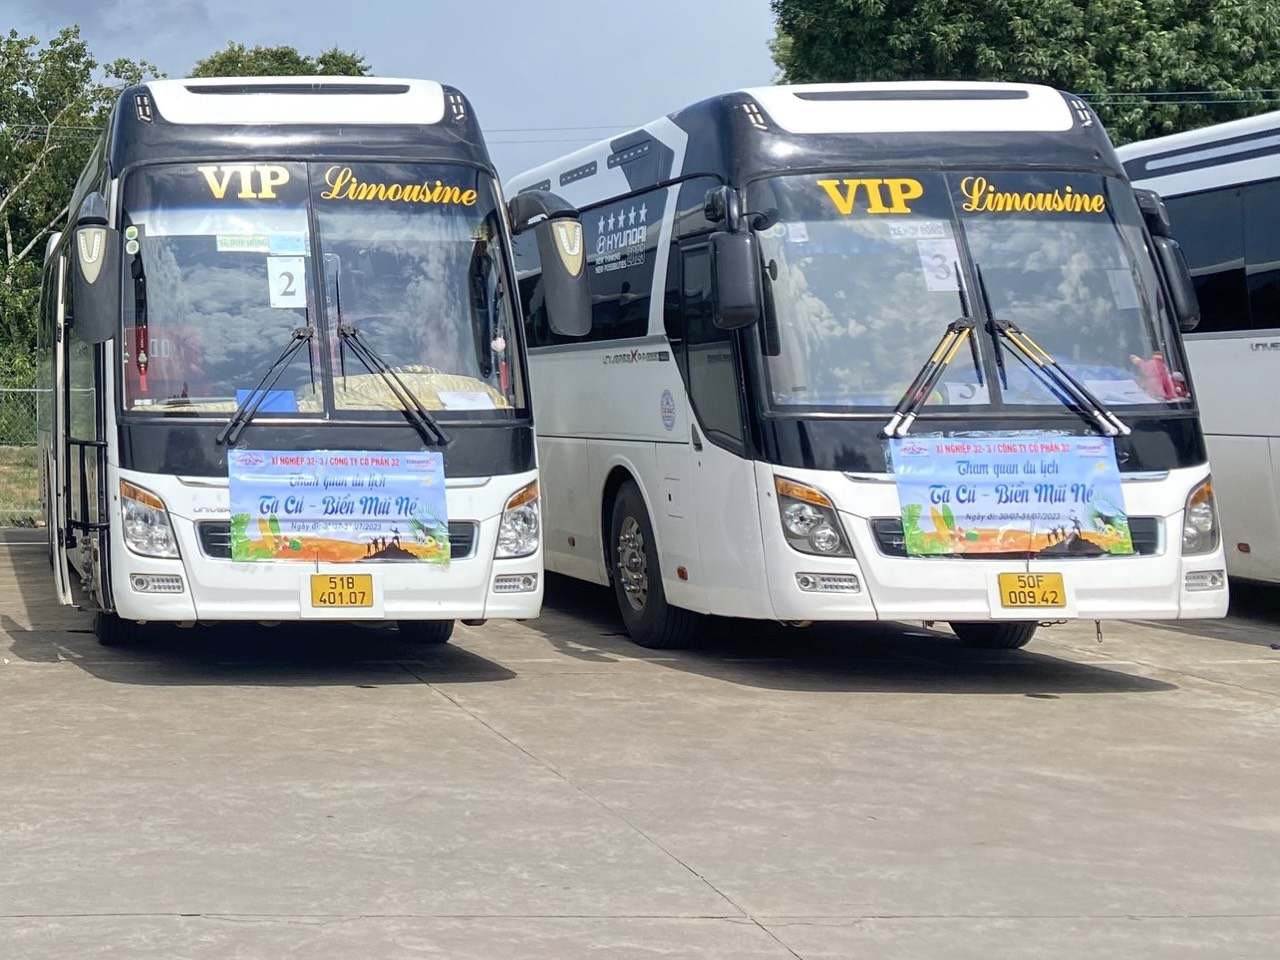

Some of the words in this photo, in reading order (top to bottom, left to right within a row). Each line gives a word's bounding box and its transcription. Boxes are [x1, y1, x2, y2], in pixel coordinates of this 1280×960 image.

[198, 166, 290, 198] VIP
[320, 166, 477, 206] Limousine
[817, 178, 923, 214] VIP
[960, 176, 1105, 212] Limousine
[606, 226, 646, 250] HYUNDAI
[932, 254, 950, 280] 3
[278, 271, 296, 296] 2
[1061, 444, 1070, 452] 32
[392, 458, 400, 467] 32
[956, 460, 989, 475] Tham
[994, 463, 1018, 478] quan
[1024, 460, 1036, 474] du
[1041, 460, 1059, 477] lịch
[956, 484, 977, 504] Cú
[995, 481, 1029, 504] Biển
[1071, 483, 1094, 503] Né
[284, 495, 304, 514] Cú
[322, 494, 355, 516] Biển
[395, 496, 419, 516] Né
[291, 522, 310, 531] Ngày
[323, 522, 381, 530] 307-3107/2023
[329, 577, 355, 589] 51B
[1017, 575, 1044, 588] 50F
[319, 592, 366, 604] 401.07
[1008, 591, 1059, 604] 009.42
